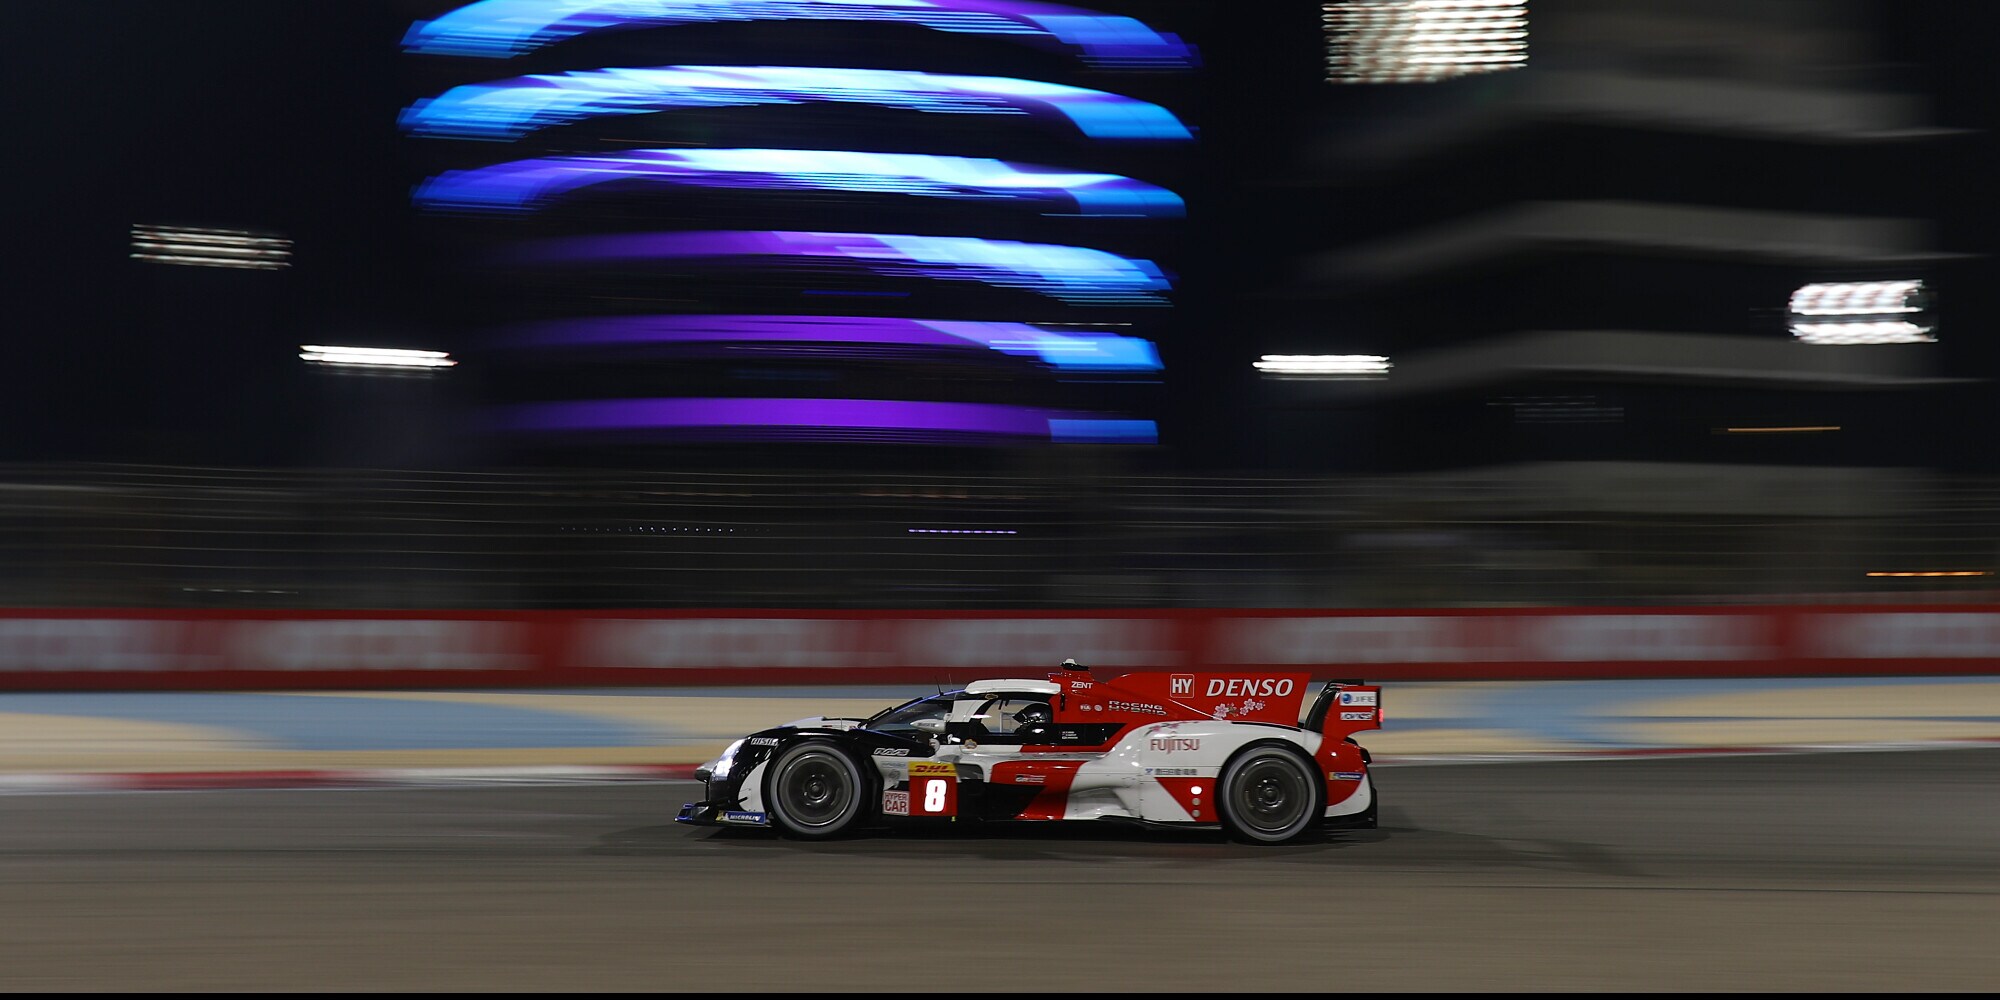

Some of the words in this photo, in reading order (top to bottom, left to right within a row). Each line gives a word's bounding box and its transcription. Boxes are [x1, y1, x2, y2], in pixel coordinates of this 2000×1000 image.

[1071, 681, 1093, 689] ZENT
[1172, 678, 1193, 694] HY
[1206, 678, 1294, 697] DENSO
[1150, 737, 1200, 754] FUJITSU
[915, 765, 949, 773] DHL
[884, 792, 907, 801] HYPER
[924, 779, 947, 812] 8
[884, 800, 907, 812] CAR
